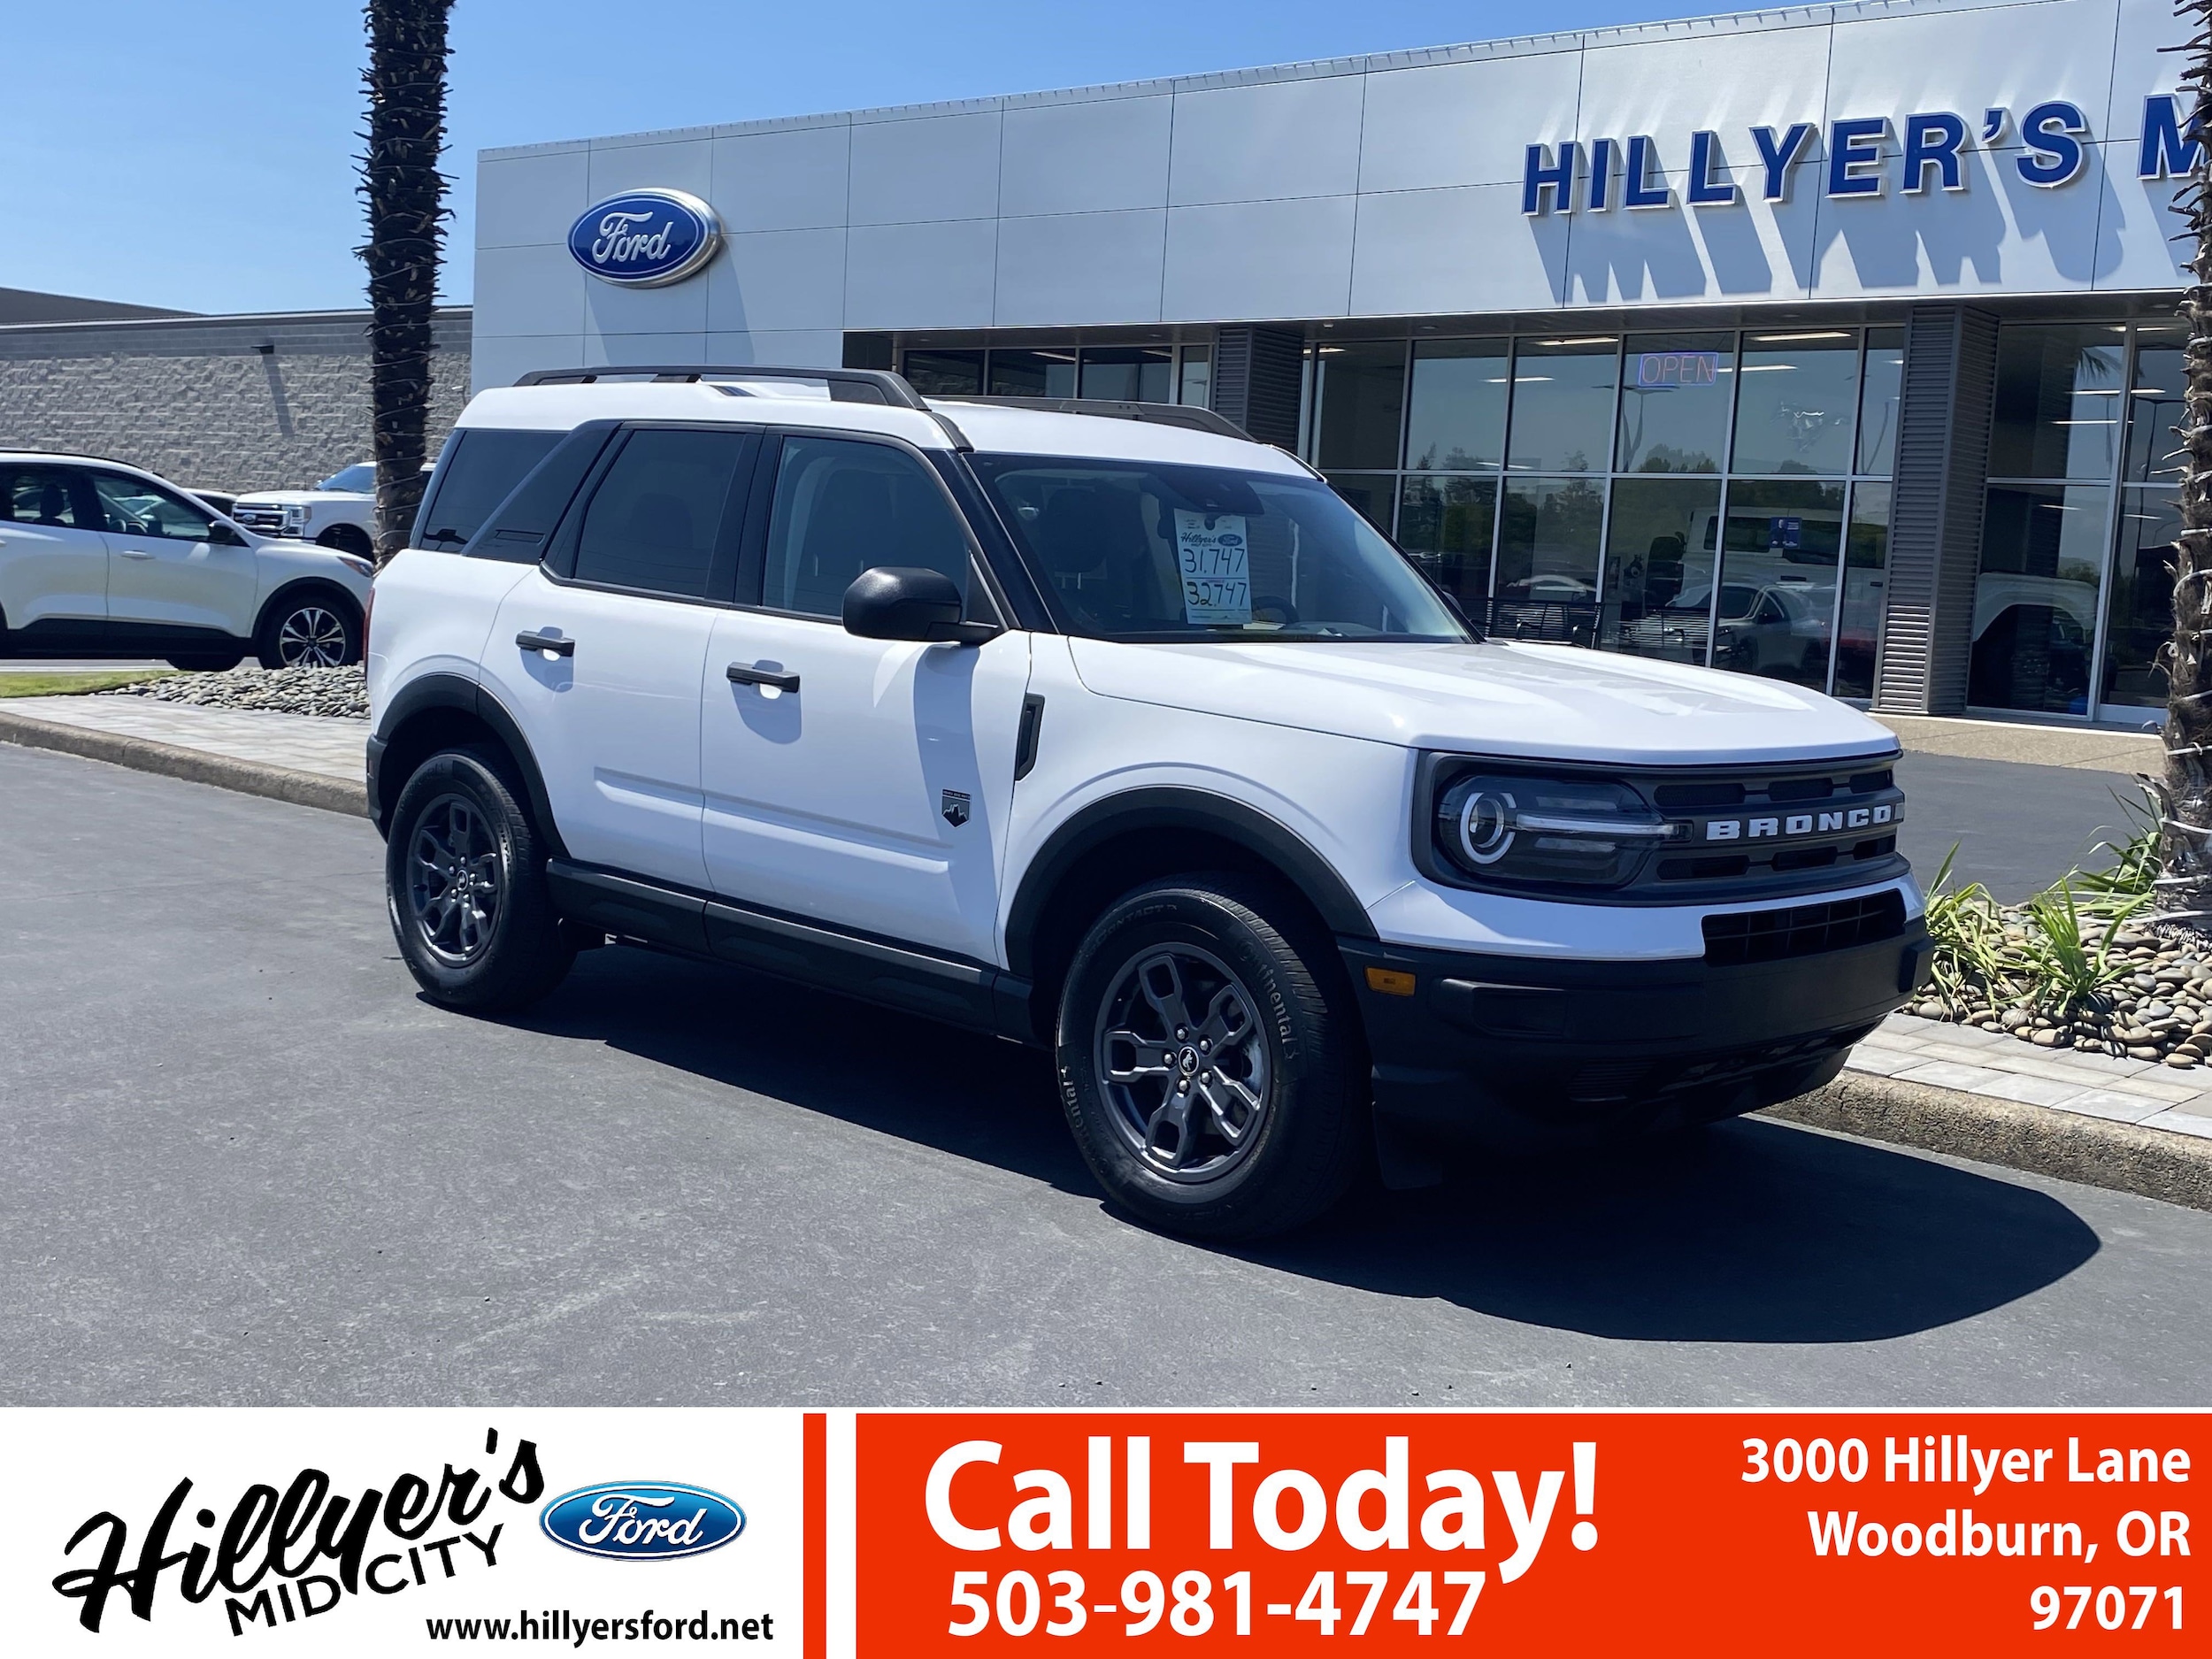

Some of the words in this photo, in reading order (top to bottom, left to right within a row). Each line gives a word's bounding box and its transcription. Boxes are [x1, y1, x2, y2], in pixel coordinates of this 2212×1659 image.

[1521, 100, 2087, 216] HILLYER'S
[592, 211, 674, 264] Ford
[1642, 356, 1716, 383] OPEN
[1706, 804, 1892, 841] BRONCO
